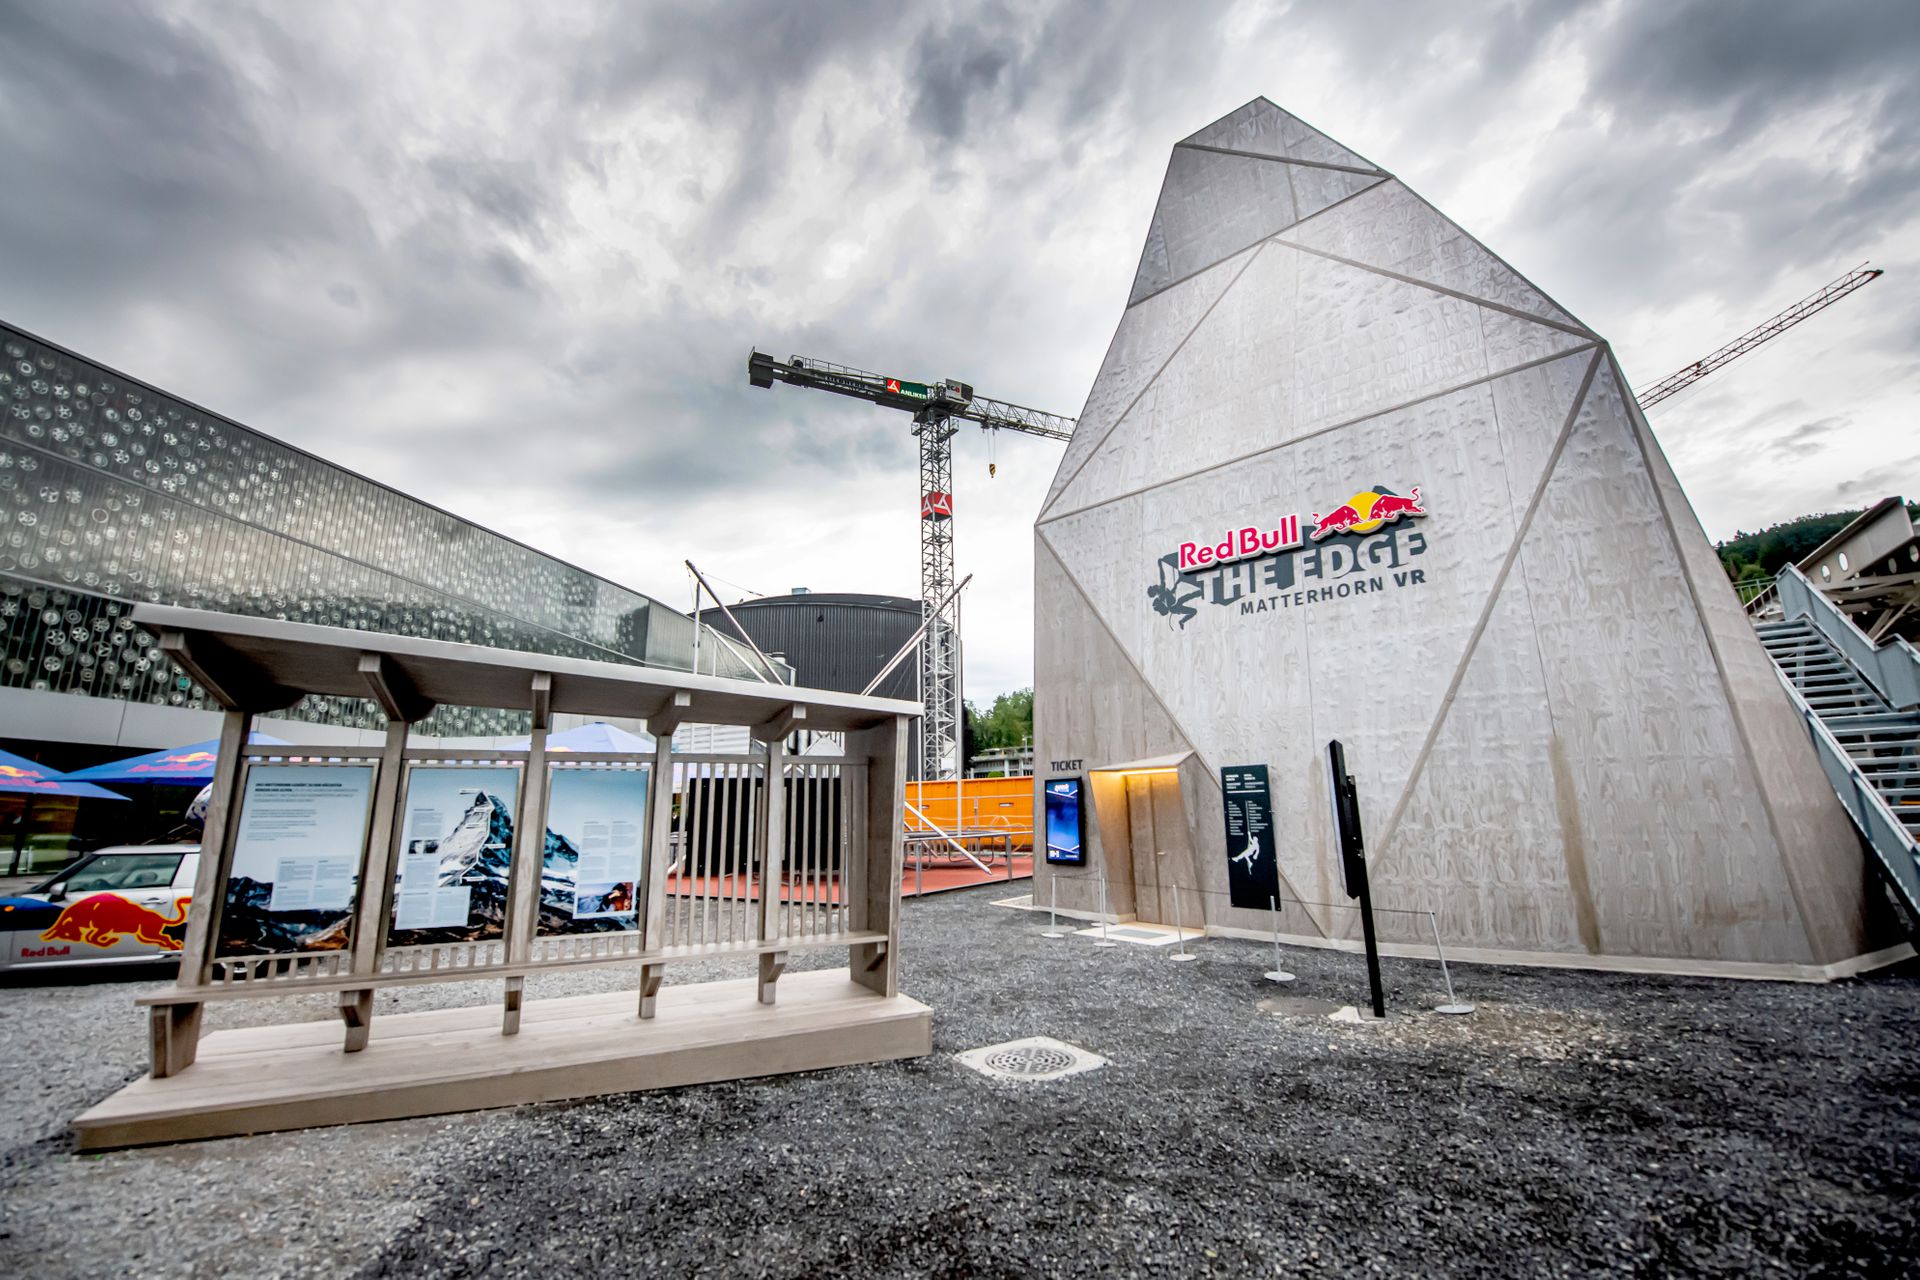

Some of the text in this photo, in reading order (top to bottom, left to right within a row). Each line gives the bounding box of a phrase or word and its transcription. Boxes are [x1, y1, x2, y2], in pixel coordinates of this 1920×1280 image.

[900, 389, 927, 400] ANLIKER
[1179, 515, 1298, 569] Red Bull
[1196, 525, 1418, 602] THE EDGE
[1240, 569, 1427, 616] MATTERHORN VR
[1051, 759, 1083, 772] TICKET
[21, 945, 70, 957] Red Bull
